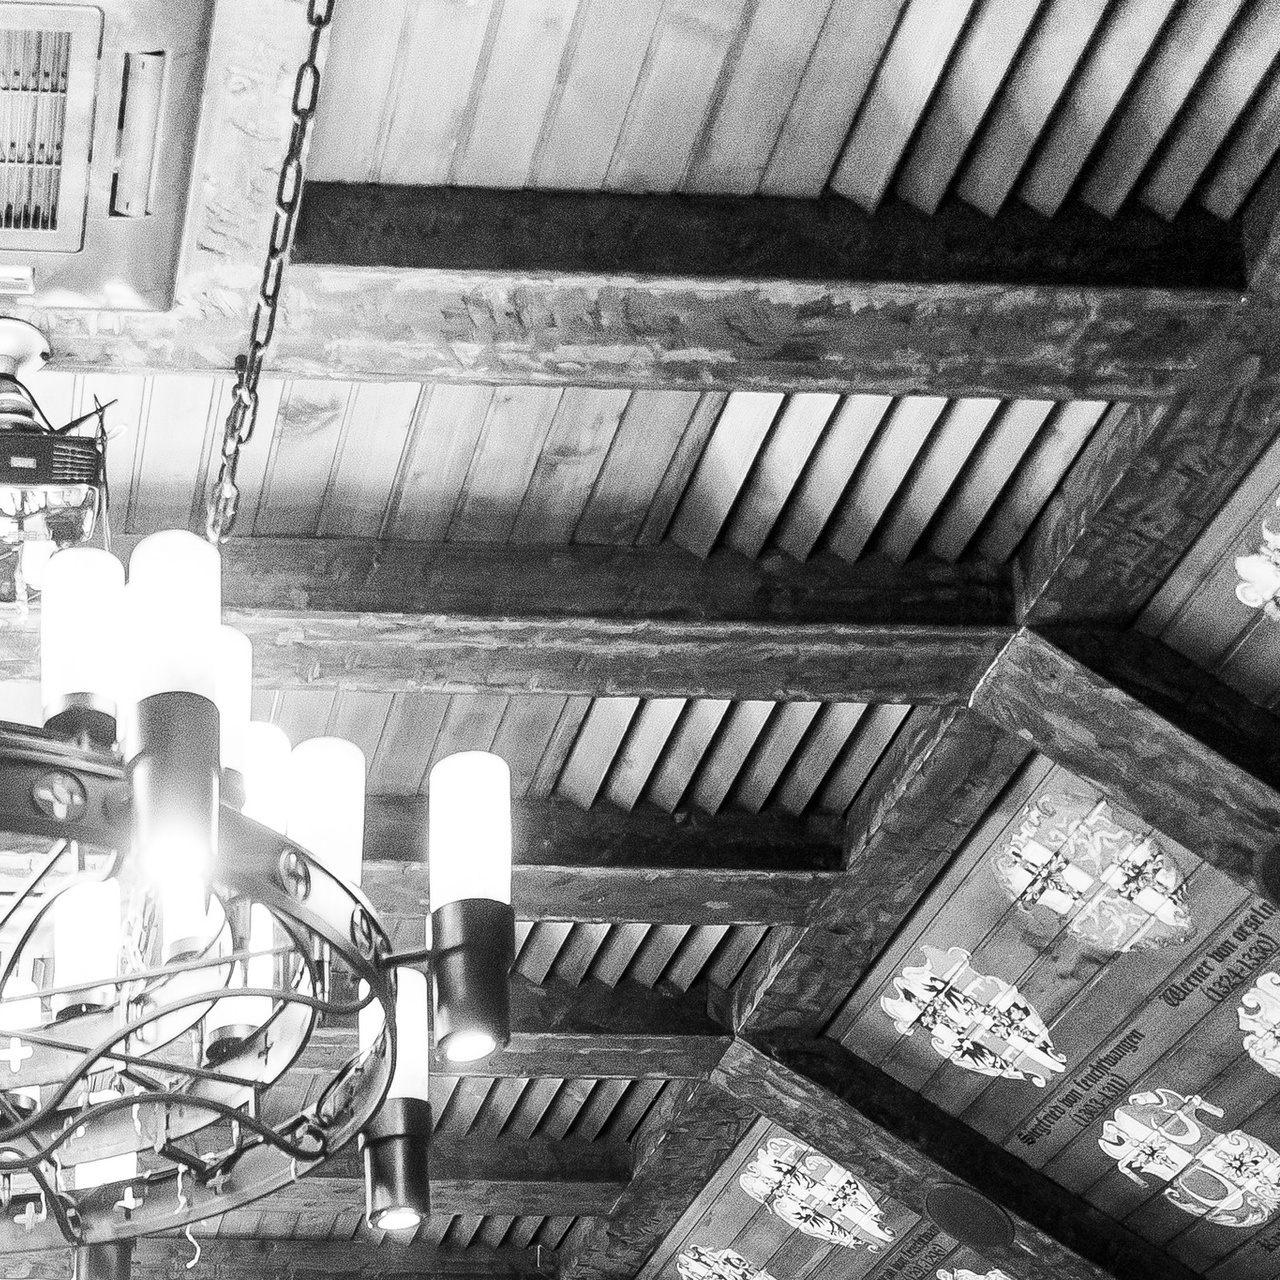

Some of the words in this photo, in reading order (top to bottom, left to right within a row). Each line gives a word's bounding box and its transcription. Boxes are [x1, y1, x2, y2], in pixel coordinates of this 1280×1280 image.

[1159, 960, 1215, 1007] Werner
[1206, 940, 1238, 963] von
[1200, 933, 1279, 1001] (1324-1330)
[1057, 1089, 1083, 1108] von
[1069, 1073, 1129, 1127] (1303-1311)
